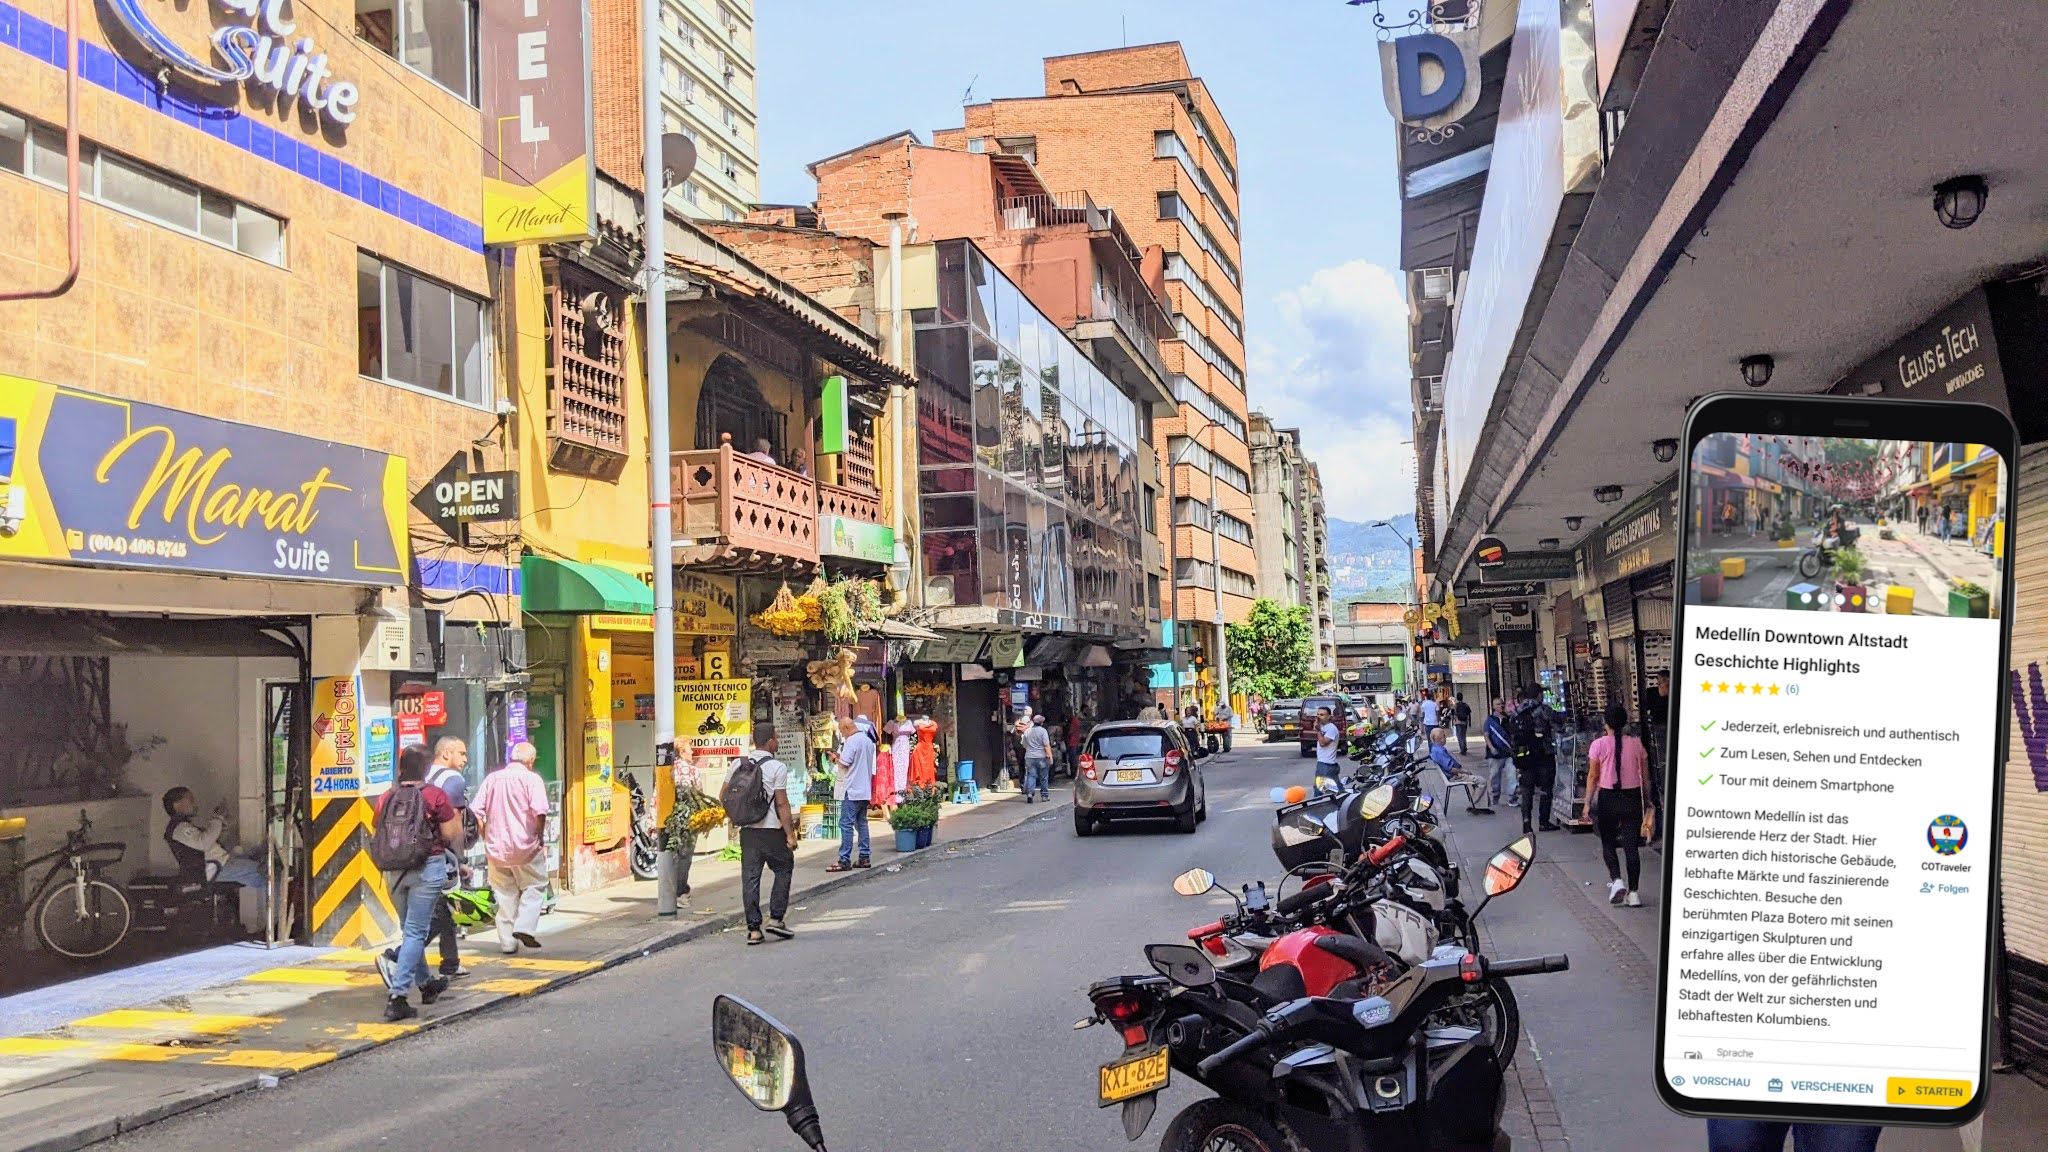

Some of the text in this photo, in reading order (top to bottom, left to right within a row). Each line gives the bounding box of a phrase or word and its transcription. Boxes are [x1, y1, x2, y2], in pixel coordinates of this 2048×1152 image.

[212, 26, 359, 123] Suite
[497, 203, 576, 233] Marat
[1941, 323, 1979, 363] TECH
[96, 425, 353, 546] Marat
[435, 478, 504, 503] OPEN
[441, 503, 500, 518] 24 HORAS
[273, 538, 330, 572] Suite
[682, 692, 737, 702] MECÁNICA DE
[713, 682, 748, 692] TÉCNICO
[695, 702, 724, 711] MOTOS
[334, 681, 355, 765] HOTEL
[712, 738, 718, 746] Y
[319, 766, 353, 776] ABIERTO
[314, 776, 360, 793] 24 HORAS
